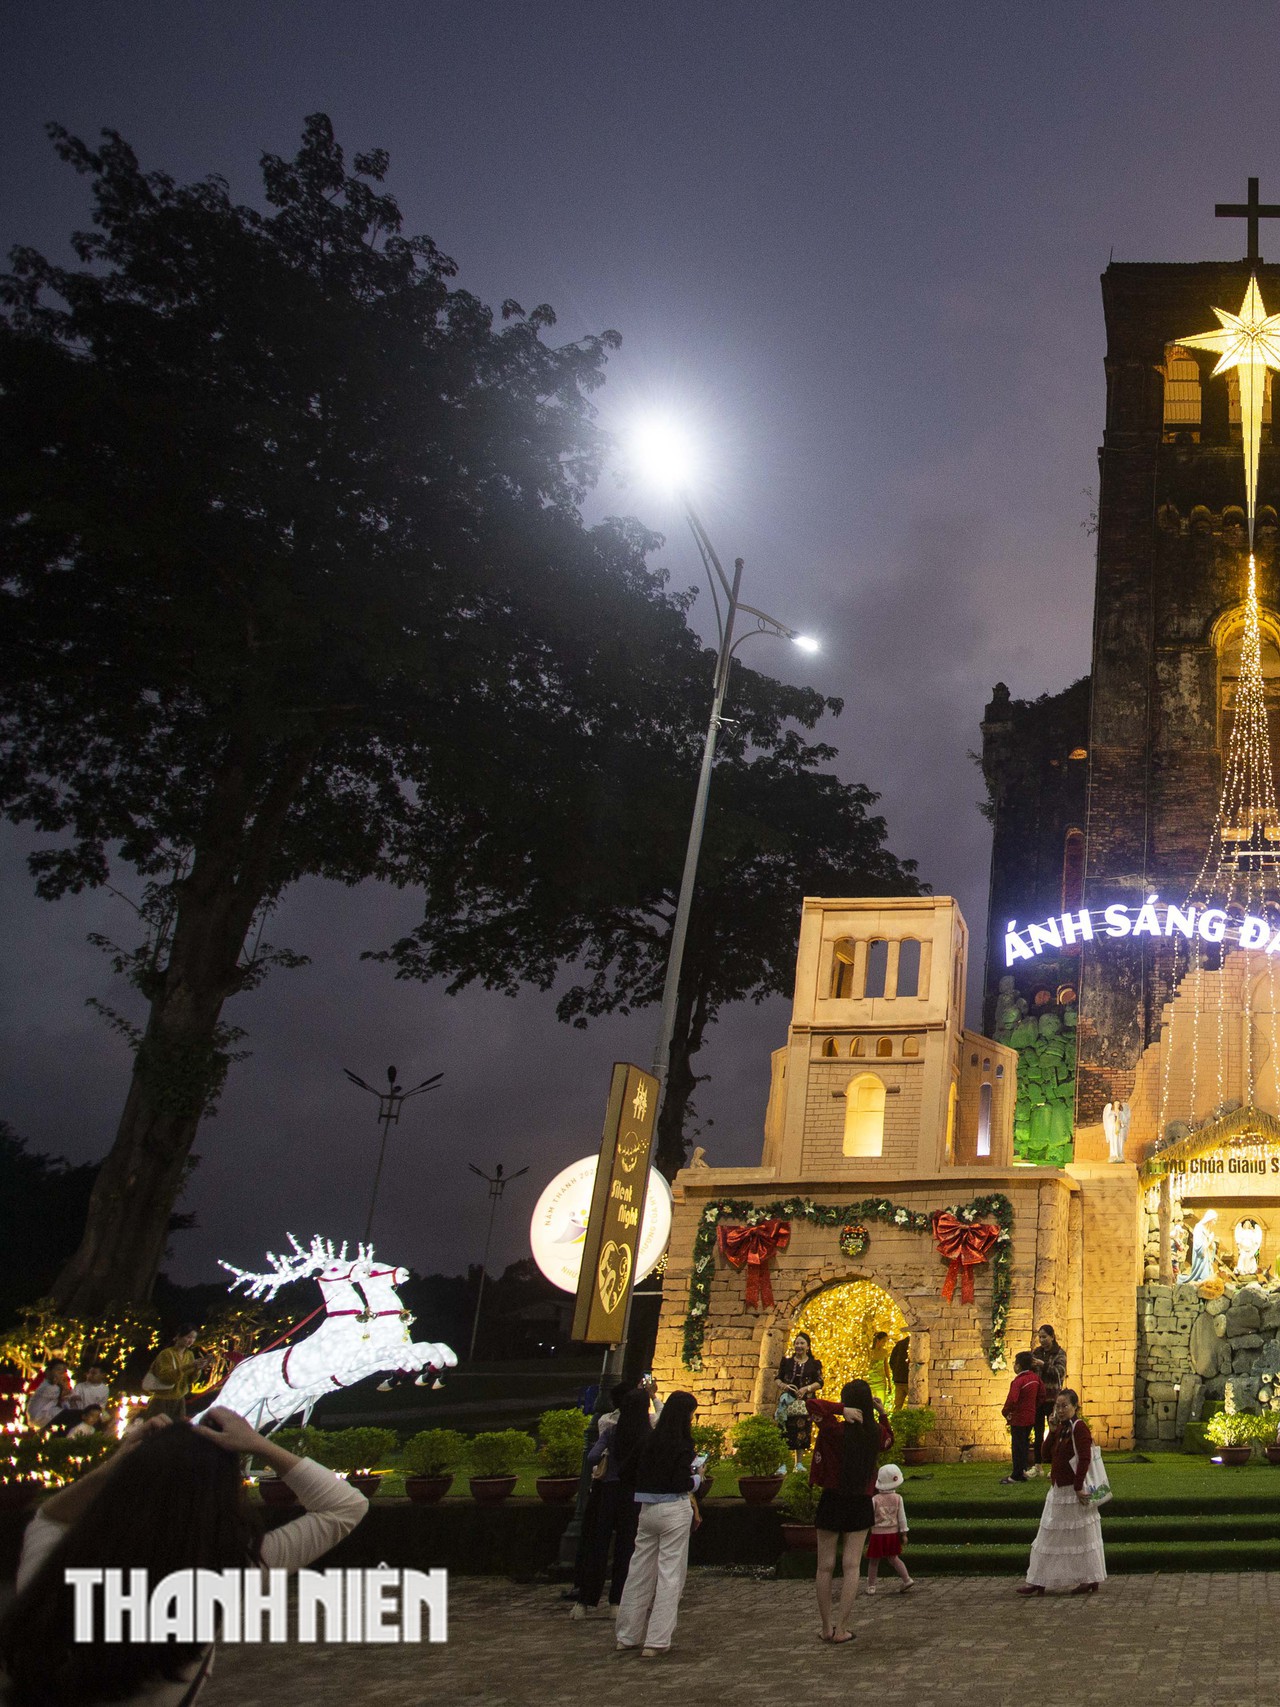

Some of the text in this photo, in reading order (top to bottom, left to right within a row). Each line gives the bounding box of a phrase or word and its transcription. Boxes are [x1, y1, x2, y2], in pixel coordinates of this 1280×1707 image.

[1005, 908, 1094, 967] ÁNH
[1104, 894, 1227, 943] SÁNG
[1190, 1156, 1224, 1174] Chúa
[1228, 1156, 1267, 1175] Giáng
[611, 1180, 633, 1202] Silent
[617, 1204, 639, 1230] Night
